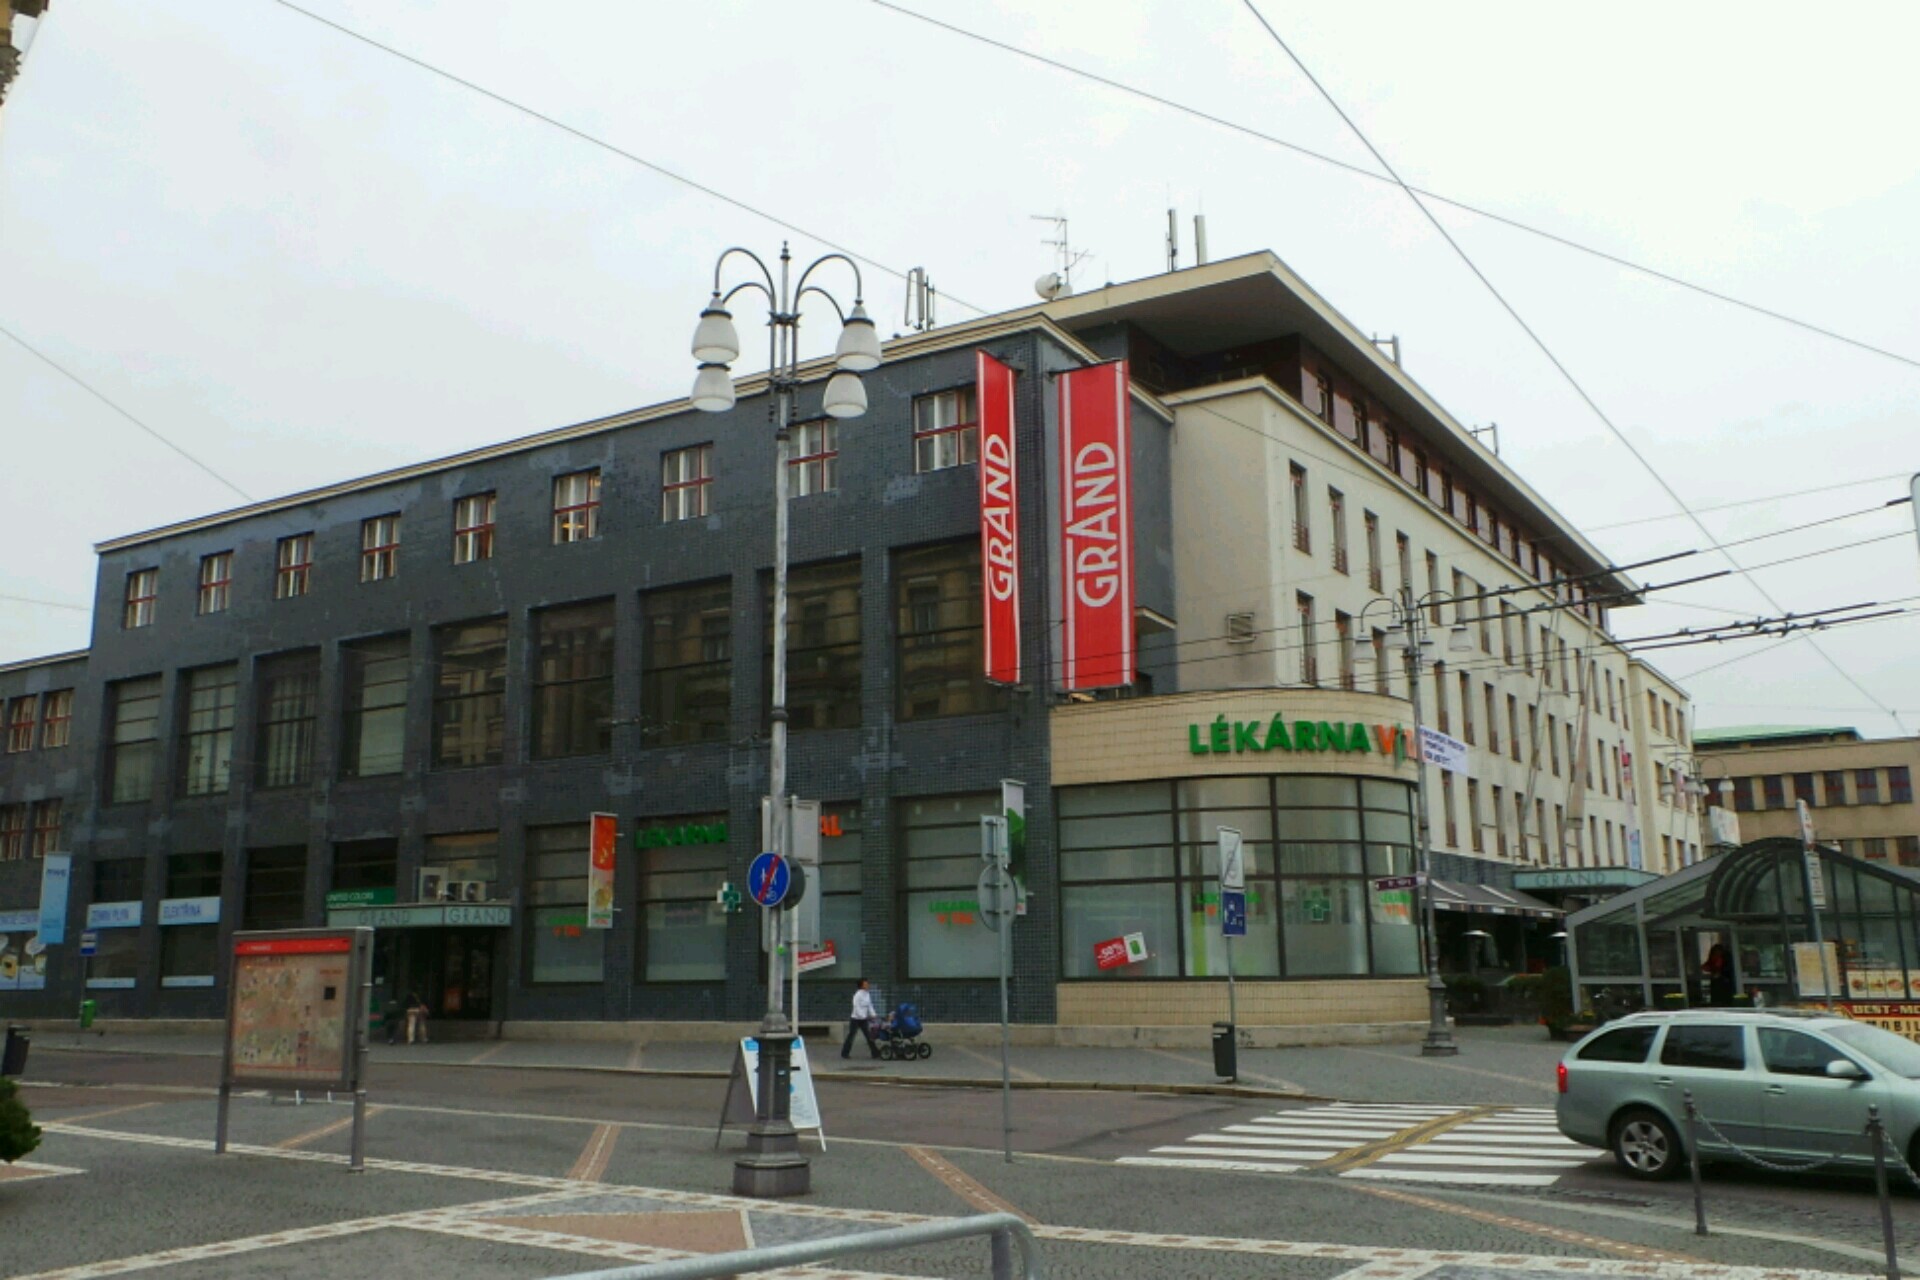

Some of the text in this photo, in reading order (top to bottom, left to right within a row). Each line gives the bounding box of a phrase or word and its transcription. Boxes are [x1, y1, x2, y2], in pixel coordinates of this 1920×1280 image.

[984, 434, 1013, 600] GRAND
[1066, 442, 1118, 607] GRAND
[1189, 711, 1371, 755] LÉKÁRNA
[1537, 872, 1606, 888] GRAND
[450, 907, 507, 924] GRAND
